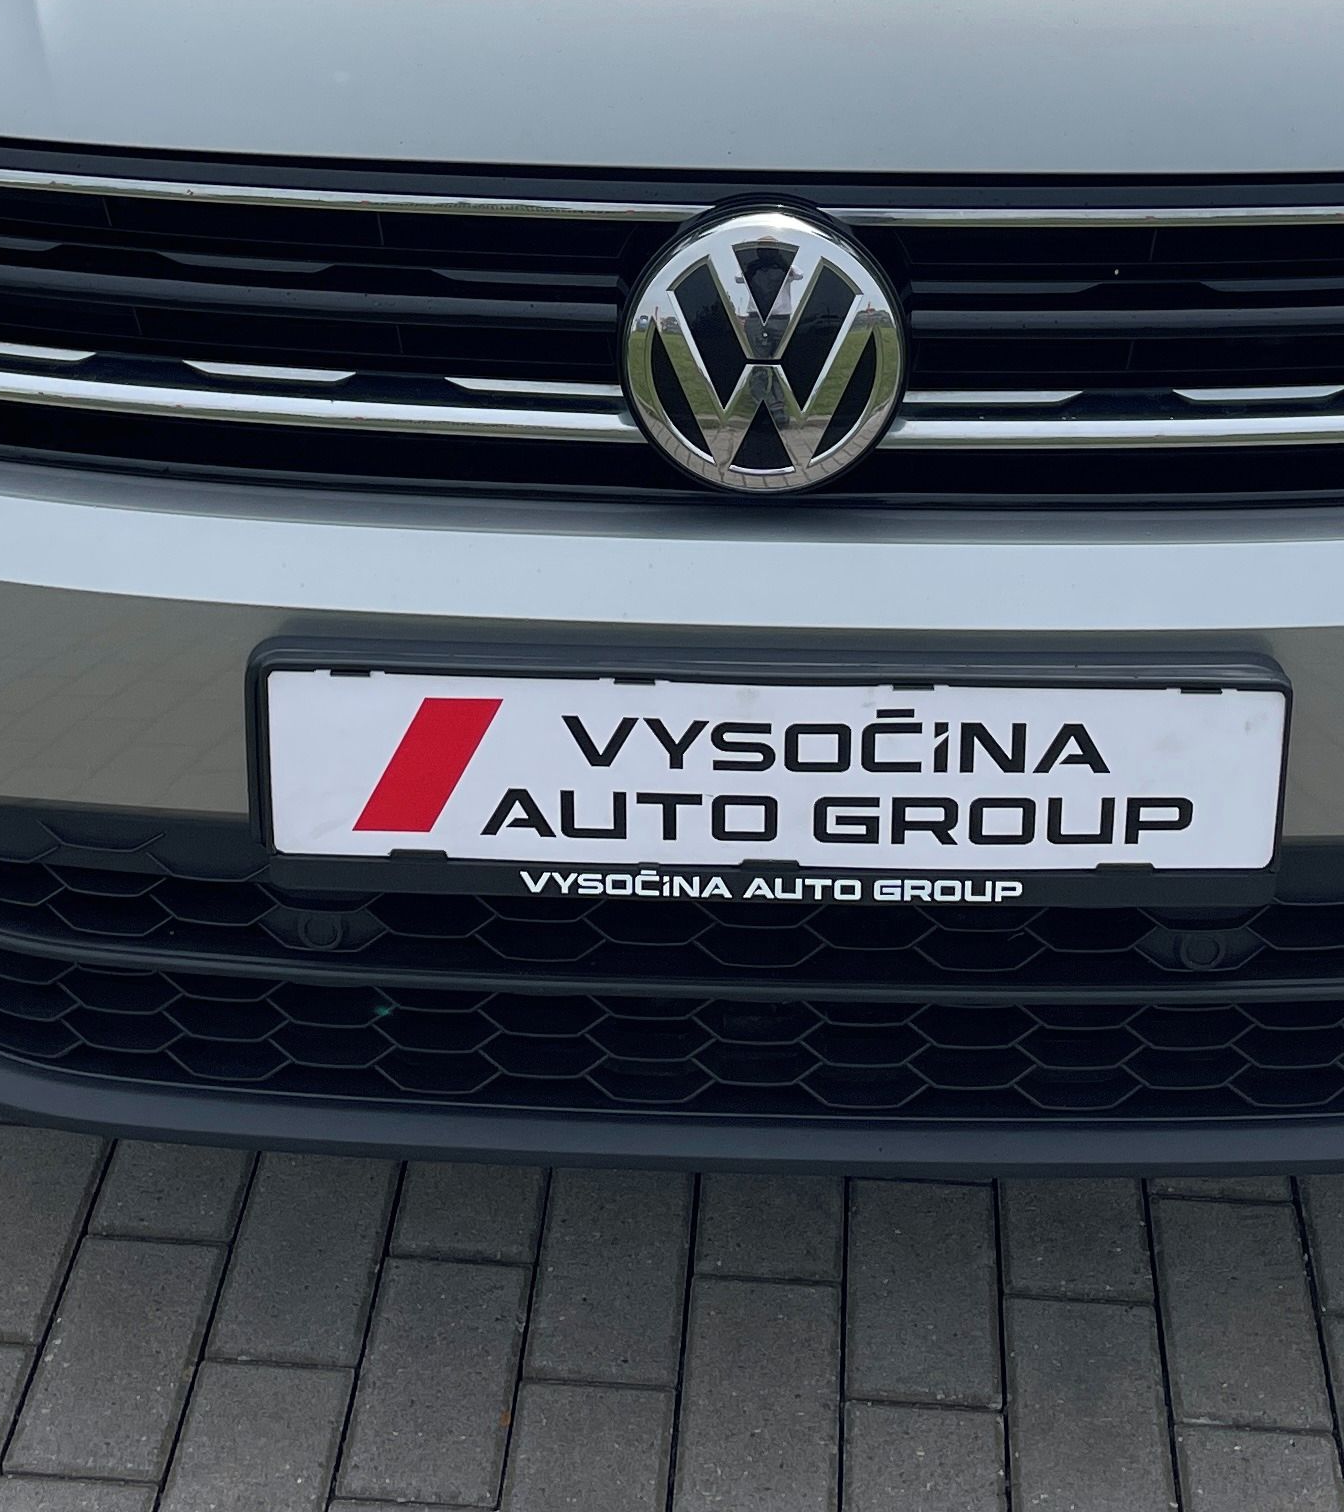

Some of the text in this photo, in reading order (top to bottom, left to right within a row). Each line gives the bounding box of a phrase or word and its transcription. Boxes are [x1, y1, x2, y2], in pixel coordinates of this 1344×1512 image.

[628, 210, 906, 494] VW
[479, 787, 1195, 847] AUTO GROUP
[742, 876, 863, 902] AUTO
[872, 878, 1024, 903] GROUP
